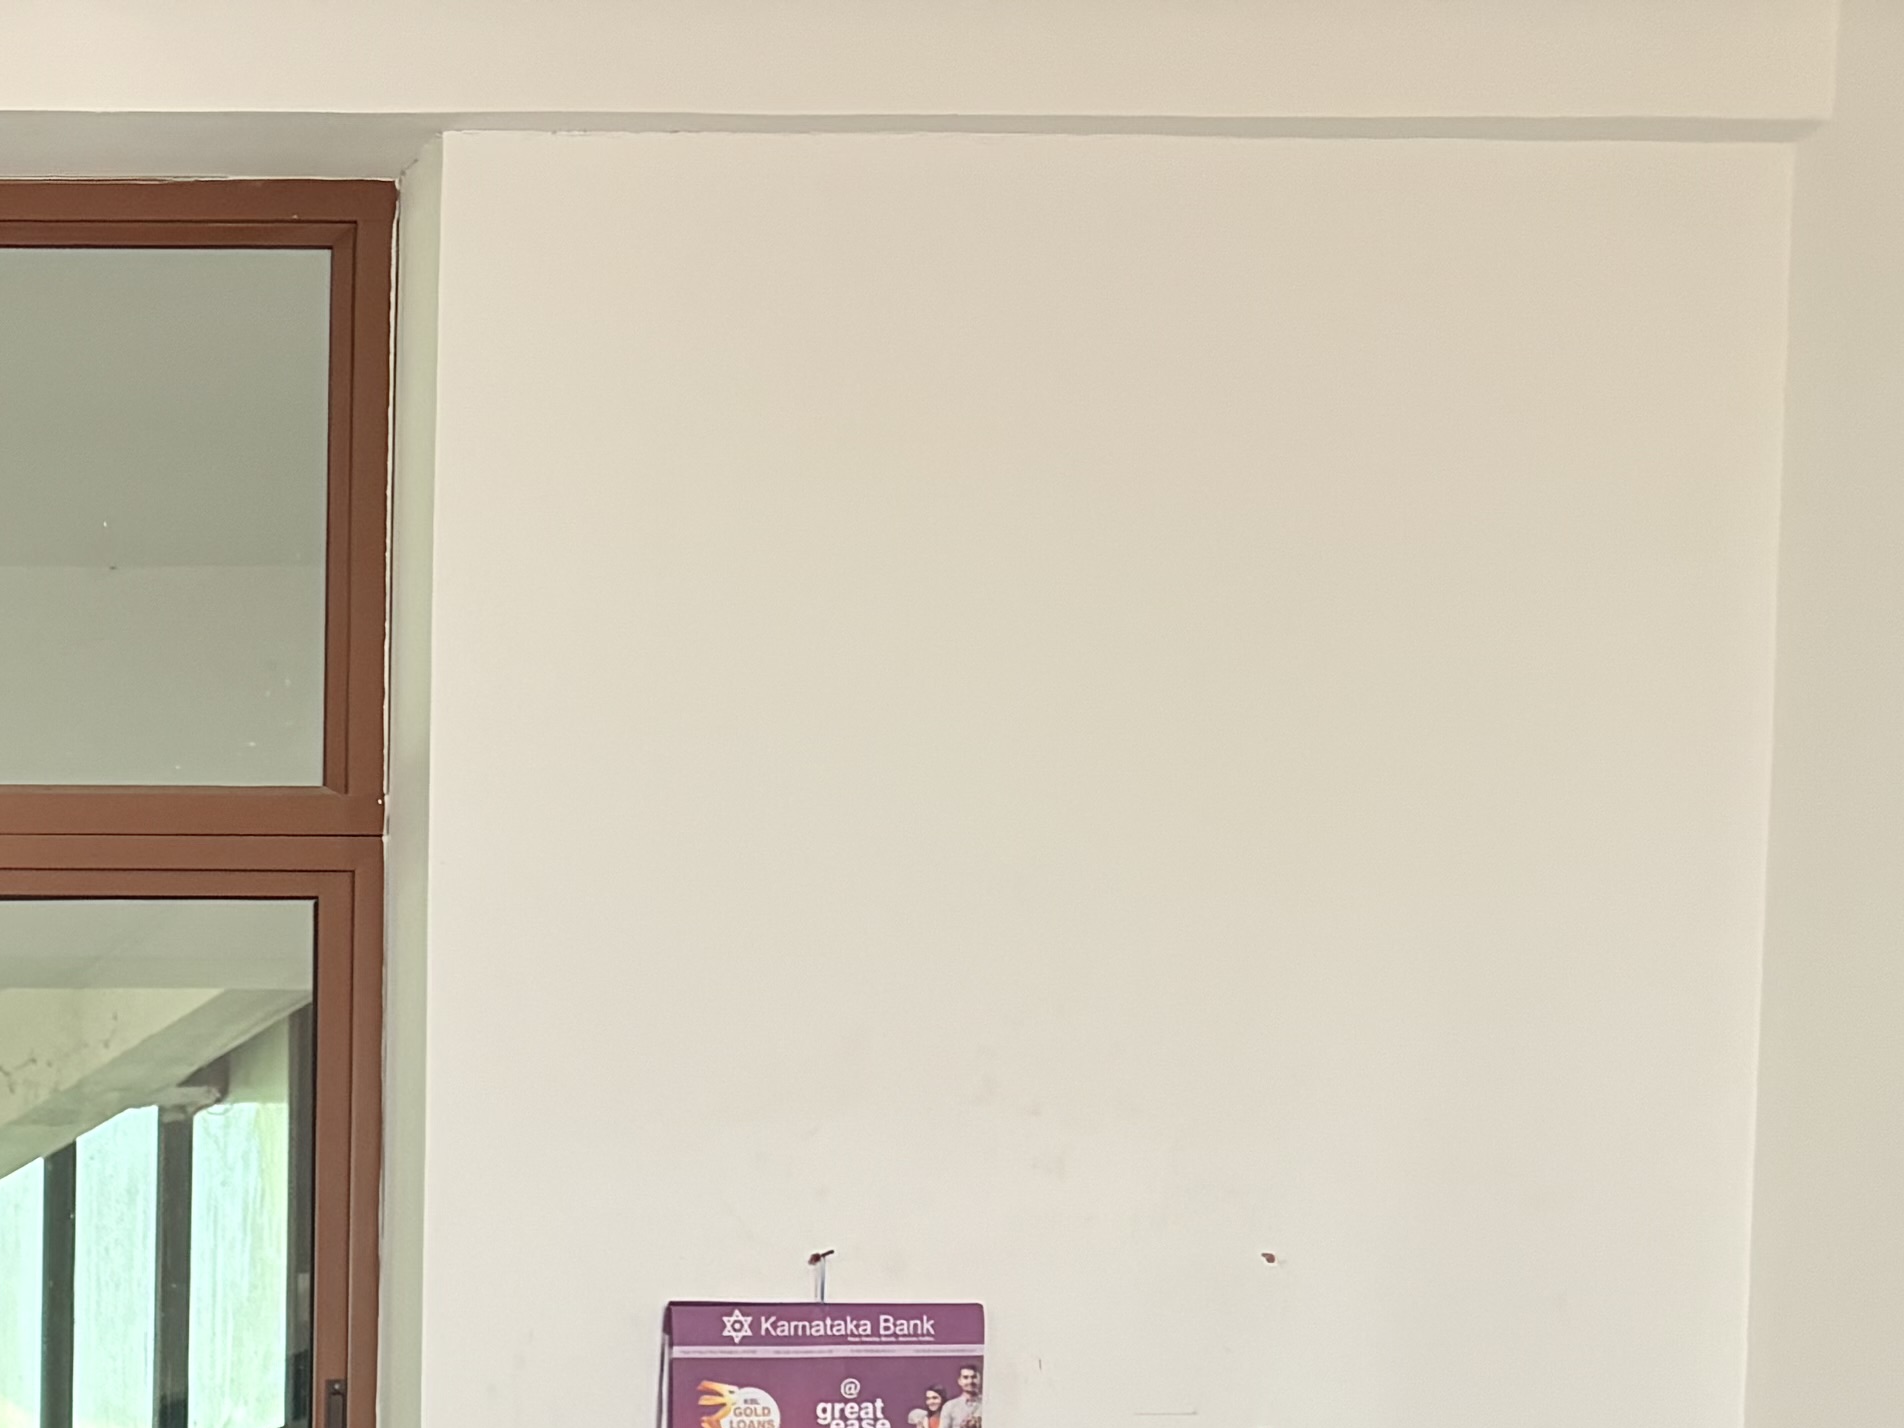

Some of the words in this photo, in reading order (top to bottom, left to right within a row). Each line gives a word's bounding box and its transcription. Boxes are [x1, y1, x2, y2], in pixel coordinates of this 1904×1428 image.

[760, 1316, 872, 1337] Karnataka
[879, 1315, 935, 1335] Bank
[840, 1378, 861, 1399] @
[733, 1406, 771, 1418] GOLD
[816, 1398, 884, 1425] great
